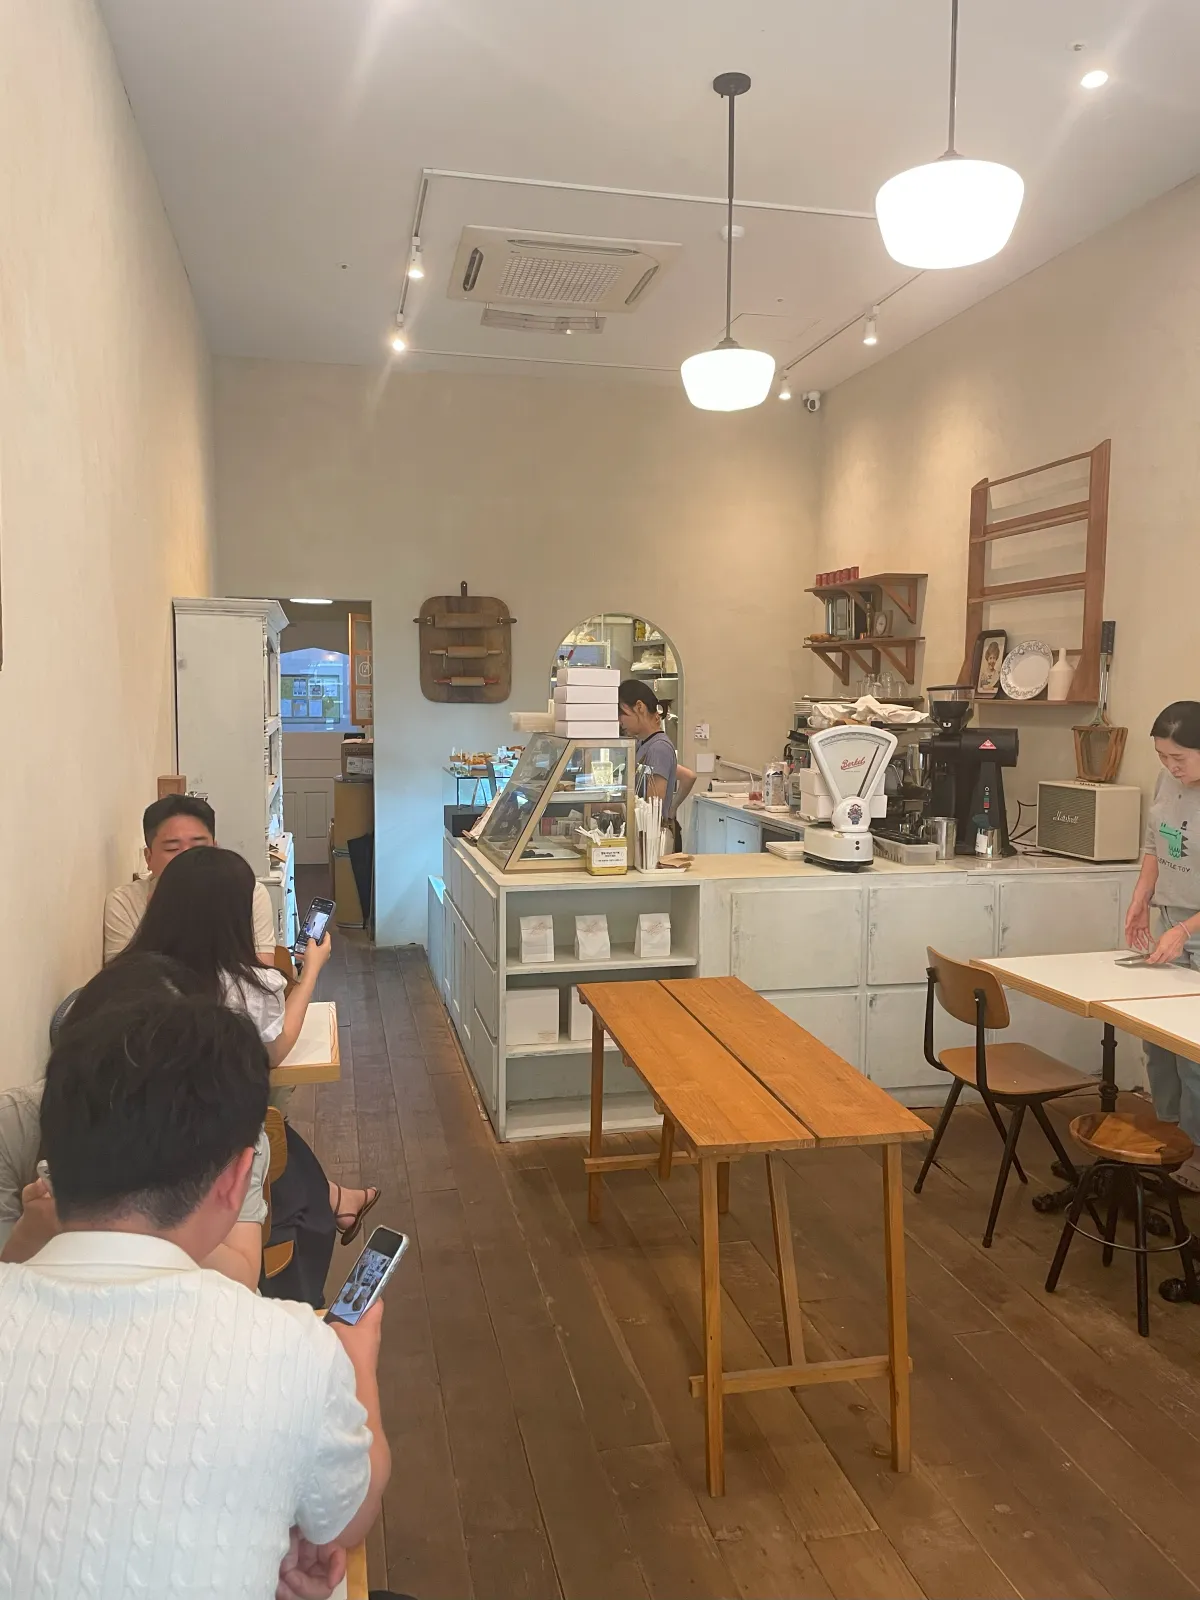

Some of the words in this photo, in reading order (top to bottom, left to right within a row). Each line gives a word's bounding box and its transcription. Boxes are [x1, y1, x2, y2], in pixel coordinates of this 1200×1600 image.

[840, 756, 866, 771] Berkel
[1052, 810, 1079, 824] Marshall
[1178, 865, 1191, 873] TOY
